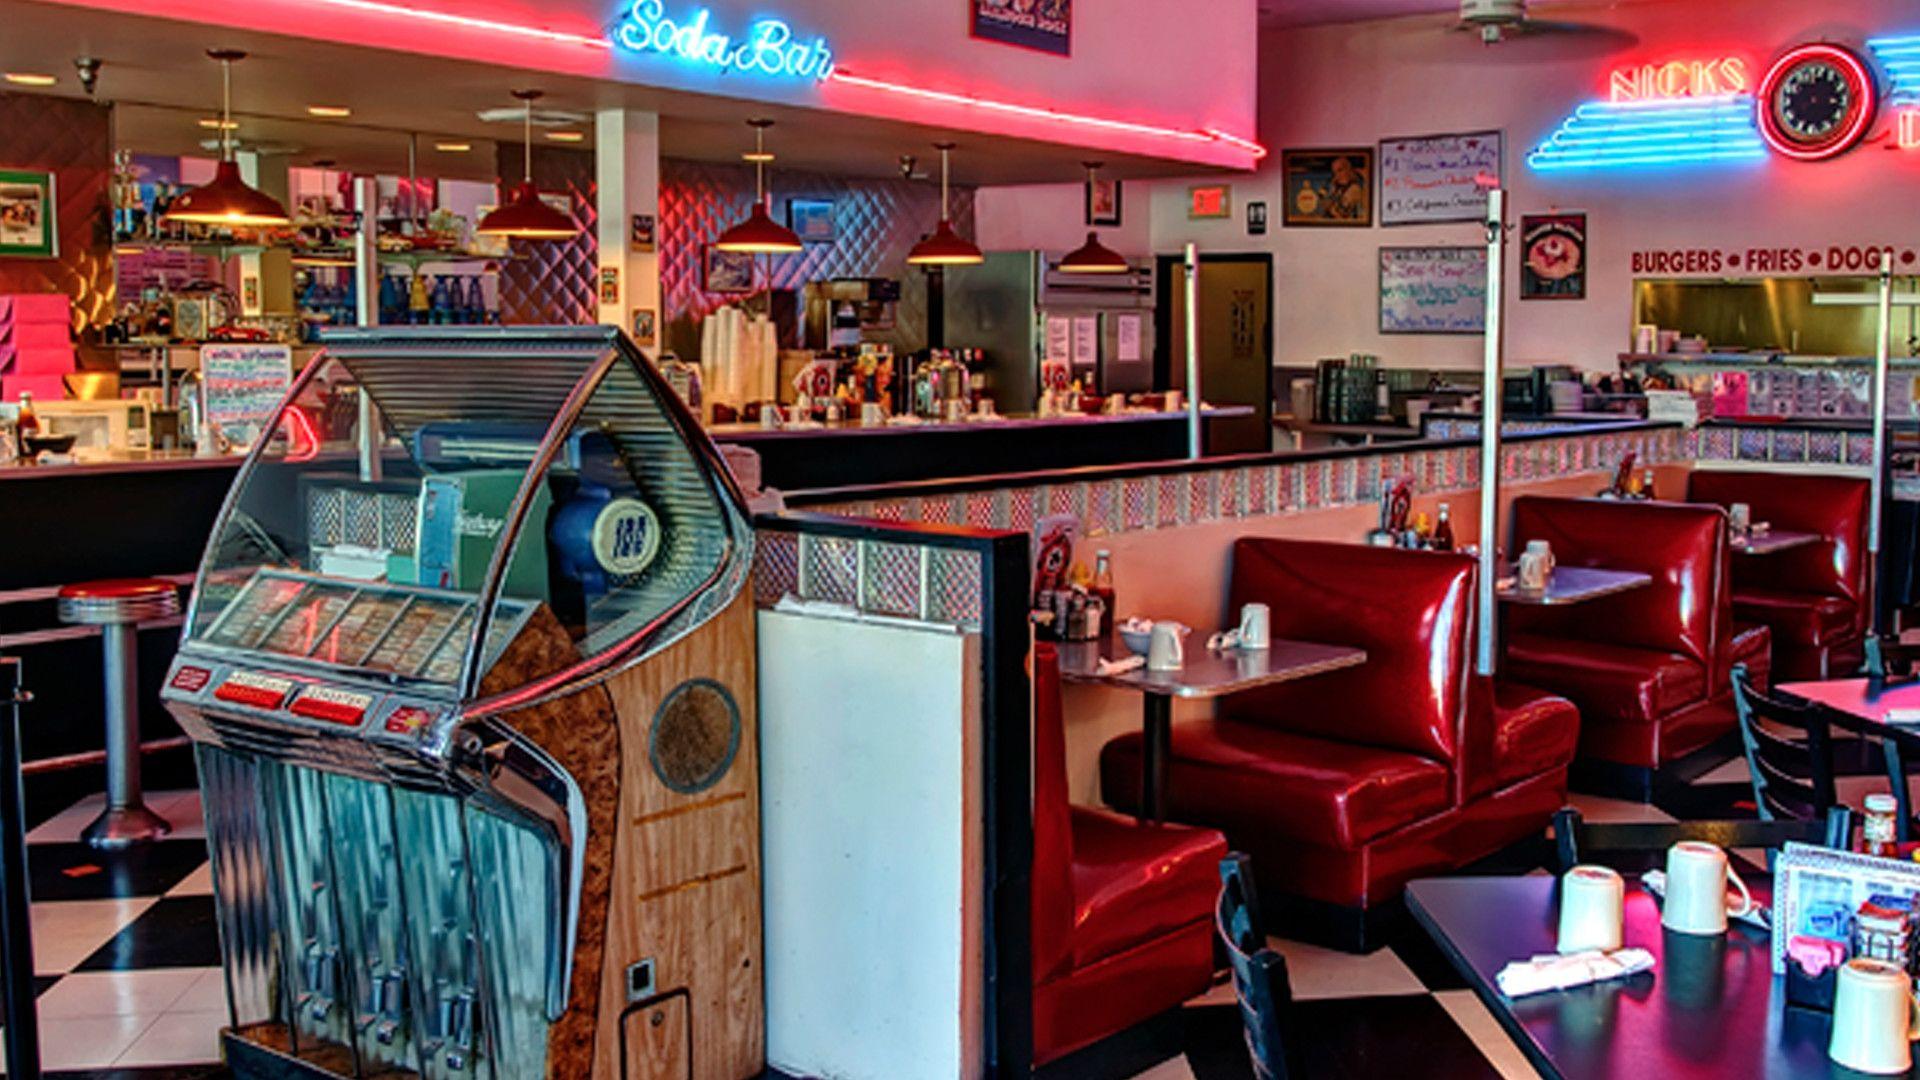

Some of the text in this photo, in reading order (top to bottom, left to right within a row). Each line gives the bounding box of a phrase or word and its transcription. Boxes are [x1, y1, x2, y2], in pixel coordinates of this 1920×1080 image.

[618, 0, 834, 80] Soda Bar
[1610, 57, 1746, 102] NICKS
[1632, 250, 1722, 273] BURGERS
[1746, 248, 1803, 271] FRIES
